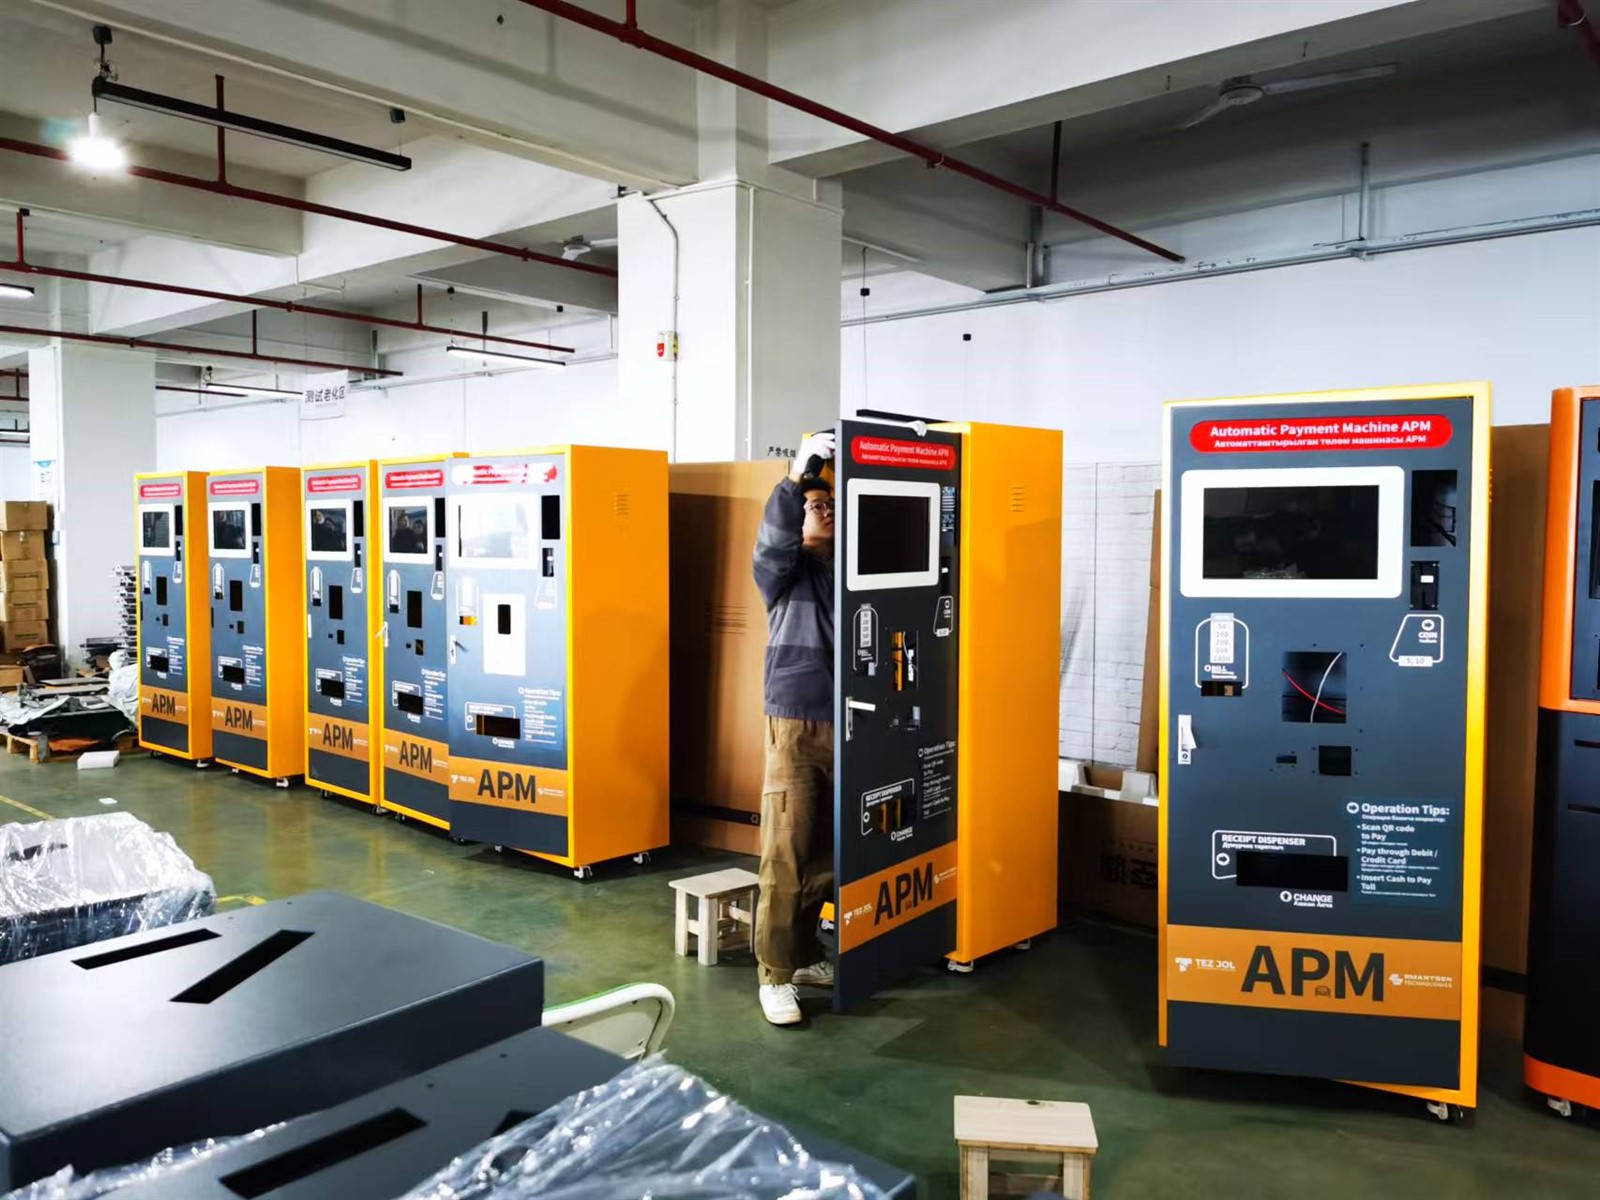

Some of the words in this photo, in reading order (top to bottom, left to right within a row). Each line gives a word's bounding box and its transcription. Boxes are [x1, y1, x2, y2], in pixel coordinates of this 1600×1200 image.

[1210, 424, 1277, 437] Automatic
[1280, 424, 1339, 437] Payment
[1342, 421, 1398, 433] Machine
[1401, 420, 1431, 431] APM
[859, 441, 889, 452] Automatic
[890, 443, 915, 455] Payment
[915, 445, 937, 456] Machine
[152, 693, 175, 716] APM
[225, 706, 252, 731] APM
[323, 723, 353, 751] APM
[399, 740, 432, 773] APM
[477, 769, 536, 804] APM
[1361, 803, 1419, 814] Operation
[1422, 805, 1450, 816] Tips:
[1361, 823, 1381, 831] Scan
[1382, 824, 1394, 832] QR
[1222, 834, 1256, 843] RECEIPT
[1258, 837, 1306, 846] DISPENSER
[1371, 833, 1386, 842] Pay
[1361, 847, 1376, 855] Pay
[1378, 848, 1409, 857] through
[1411, 849, 1433, 857] Debit
[1361, 856, 1386, 864] Credit
[1387, 857, 1406, 865] Card
[1361, 874, 1385, 882] Insert
[1386, 875, 1405, 883] Cash
[1417, 877, 1432, 886] Pay
[874, 862, 933, 926] APM
[1294, 893, 1333, 903] CHANGE
[1195, 958, 1214, 968] TEZ
[1216, 960, 1236, 969] JOL
[1240, 945, 1384, 1002] APM
[1404, 980, 1452, 988] TECHNOLOGIES
